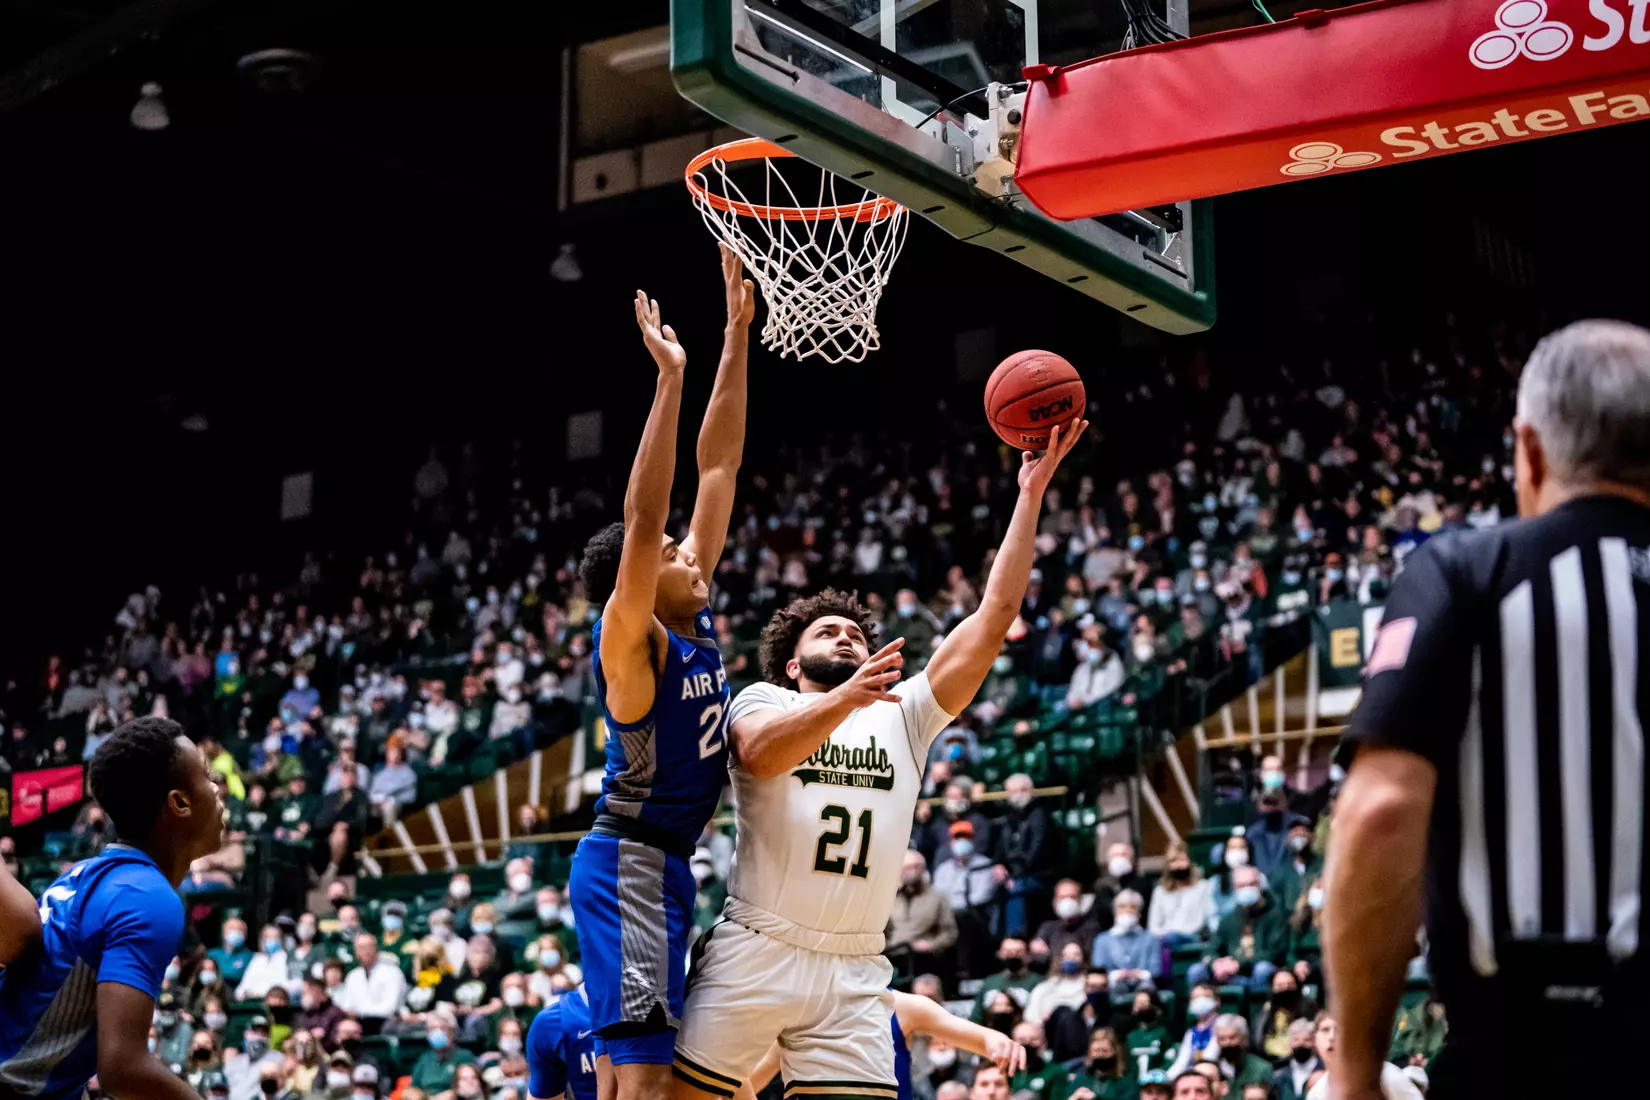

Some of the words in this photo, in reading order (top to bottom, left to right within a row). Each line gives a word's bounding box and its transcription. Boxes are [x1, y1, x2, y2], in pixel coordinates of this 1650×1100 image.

[1380, 108, 1568, 157] State
[1568, 91, 1650, 125] Fa
[1028, 395, 1073, 422] NCAA
[681, 672, 714, 700] AIR
[799, 735, 891, 773] olorado
[819, 771, 848, 786] STATE
[853, 775, 875, 788] UNIV
[811, 804, 873, 879] 21
